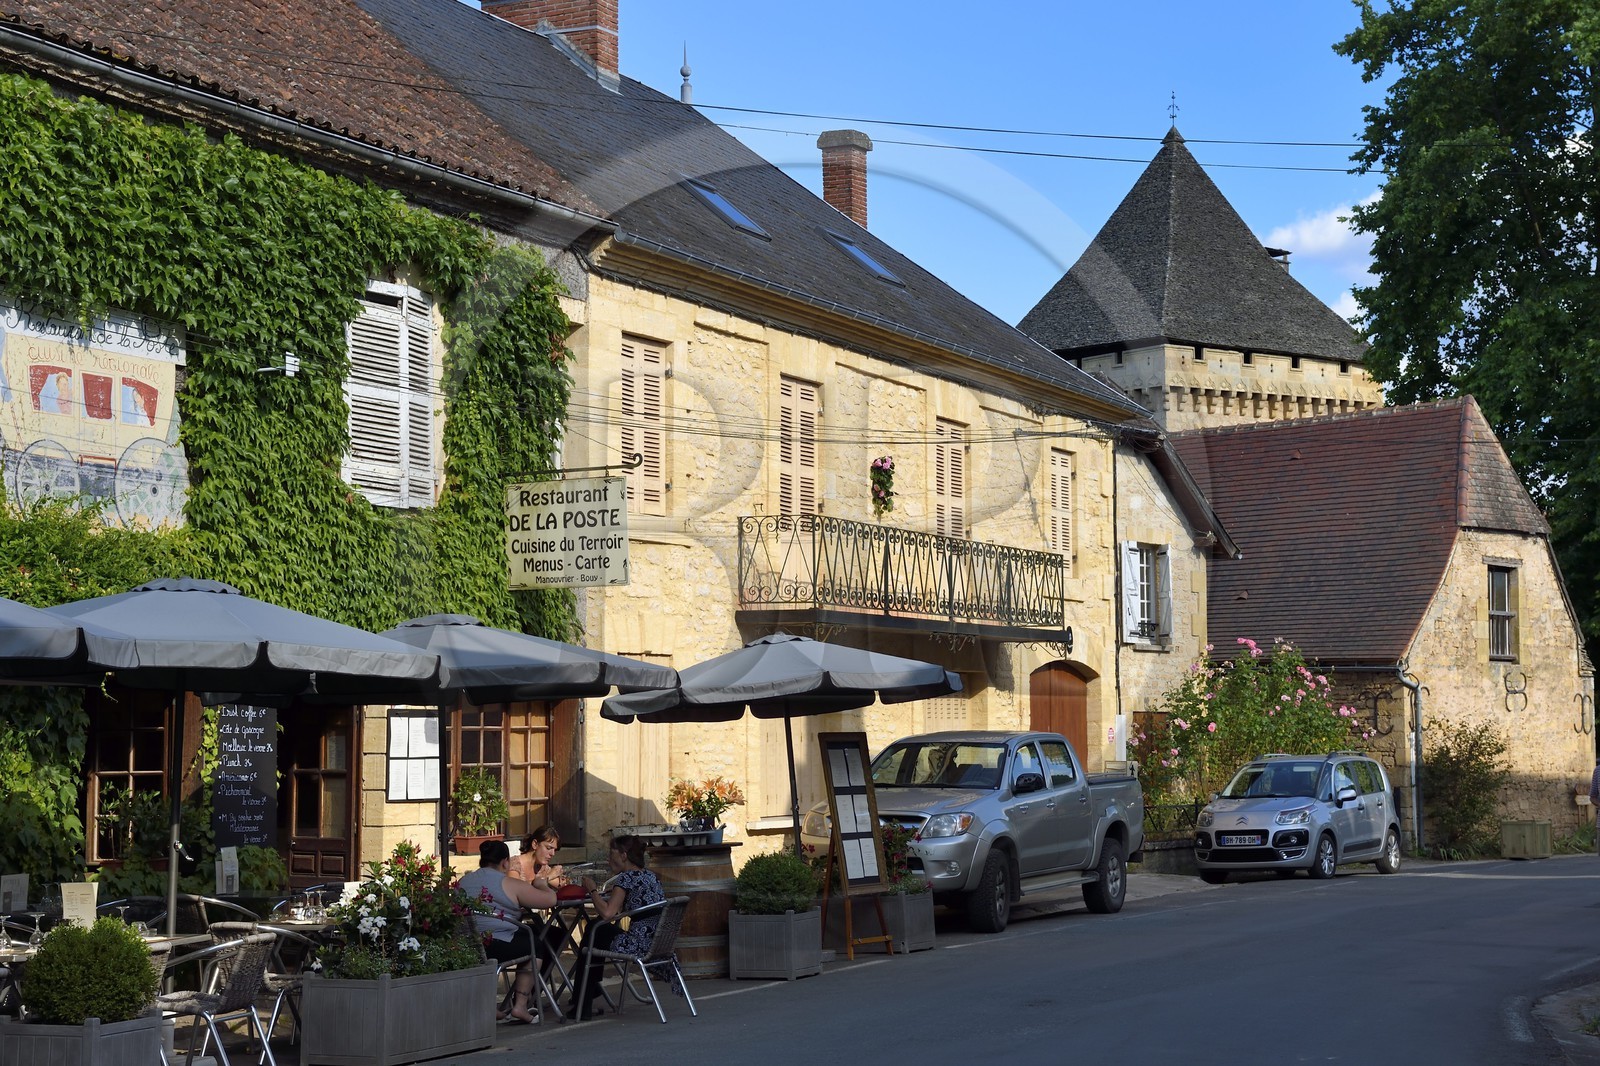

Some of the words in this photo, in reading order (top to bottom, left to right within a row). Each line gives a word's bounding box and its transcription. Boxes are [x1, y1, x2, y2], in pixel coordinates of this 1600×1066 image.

[97, 320, 114, 347] de
[117, 322, 132, 348] la
[520, 486, 609, 507] Restaurant
[510, 514, 531, 532] DE
[536, 512, 558, 530] LA
[563, 509, 621, 529] POSTE
[512, 538, 556, 554] Cuisine
[560, 537, 575, 552] du
[578, 534, 624, 551] Terroir
[523, 558, 564, 573] Menus
[575, 555, 610, 570] Carte
[535, 575, 575, 584] Manouvrier
